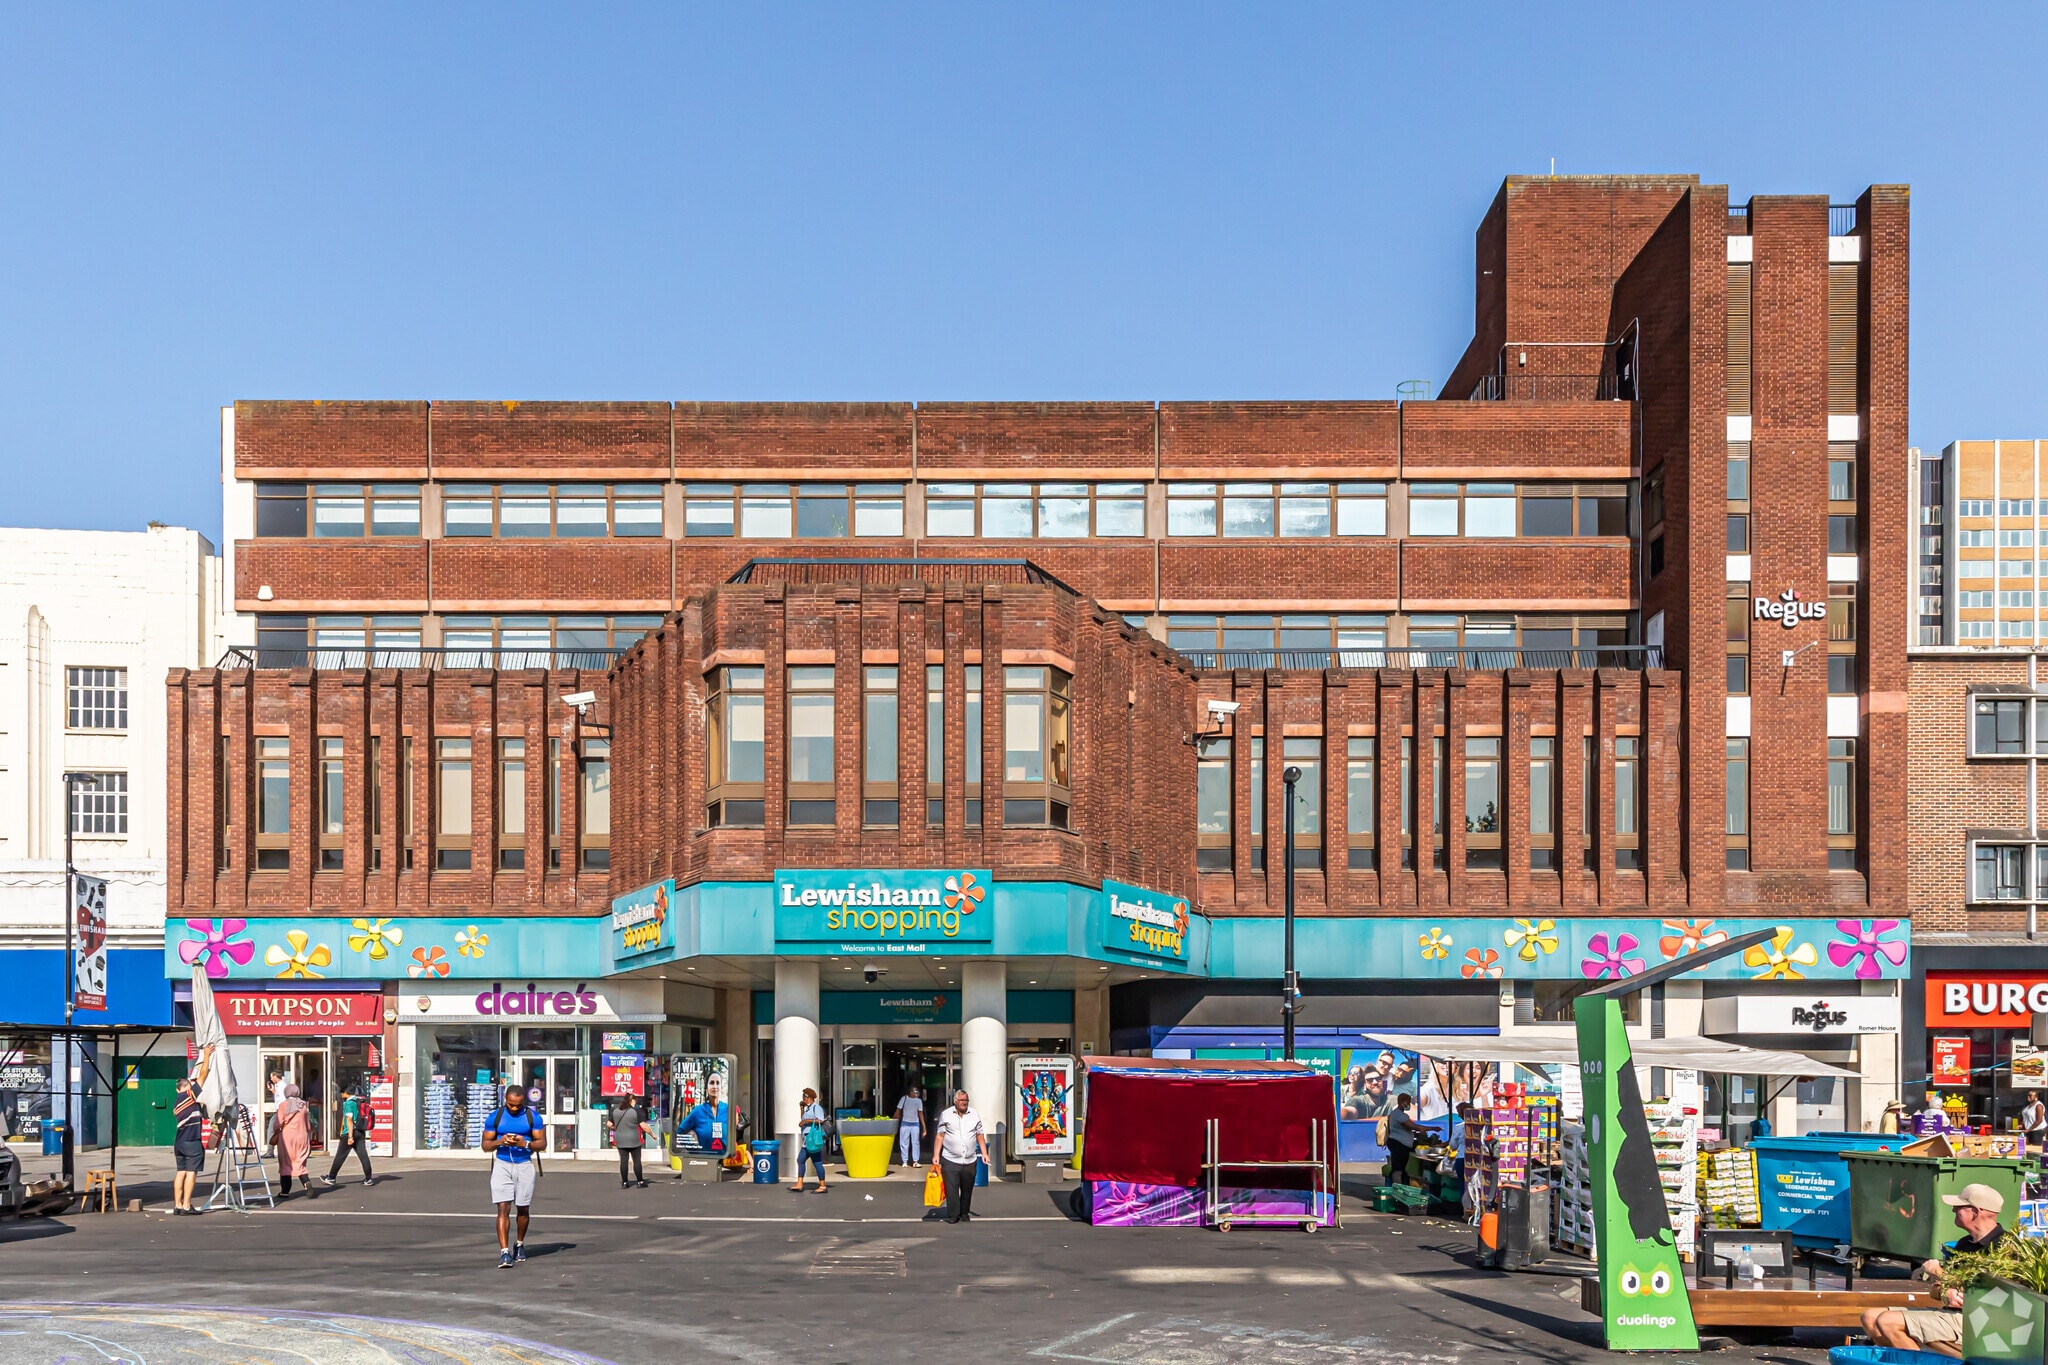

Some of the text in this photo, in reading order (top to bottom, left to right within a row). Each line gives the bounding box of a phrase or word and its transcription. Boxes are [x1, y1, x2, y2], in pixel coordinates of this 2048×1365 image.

[1754, 597, 1827, 627] Regus
[782, 883, 941, 906] Lewisham
[827, 901, 960, 937] shopping
[1110, 894, 1175, 928] Lewisham
[623, 920, 661, 952] shopping
[1129, 916, 1181, 956] shopping
[841, 944, 876, 952] Welcome
[887, 944, 905, 952] East
[906, 944, 926, 952] Mall
[230, 998, 352, 1016] TIMPSON
[475, 982, 597, 1015] claire's
[880, 998, 933, 1006] Lewisham
[1945, 983, 2048, 1014] BURG
[1791, 1006, 1847, 1032] Regus
[677, 1062, 703, 1073] I WILL
[1311, 1057, 1331, 1068] days
[614, 1073, 632, 1081] UP TO
[1676, 1071, 1695, 1080] Regus
[1784, 1184, 1826, 1192] REGENERATION
[1795, 1175, 1836, 1186] Lewisham
[1777, 1191, 1813, 1199] COMMERCIAL
[1616, 1313, 1676, 1329] duolingo
